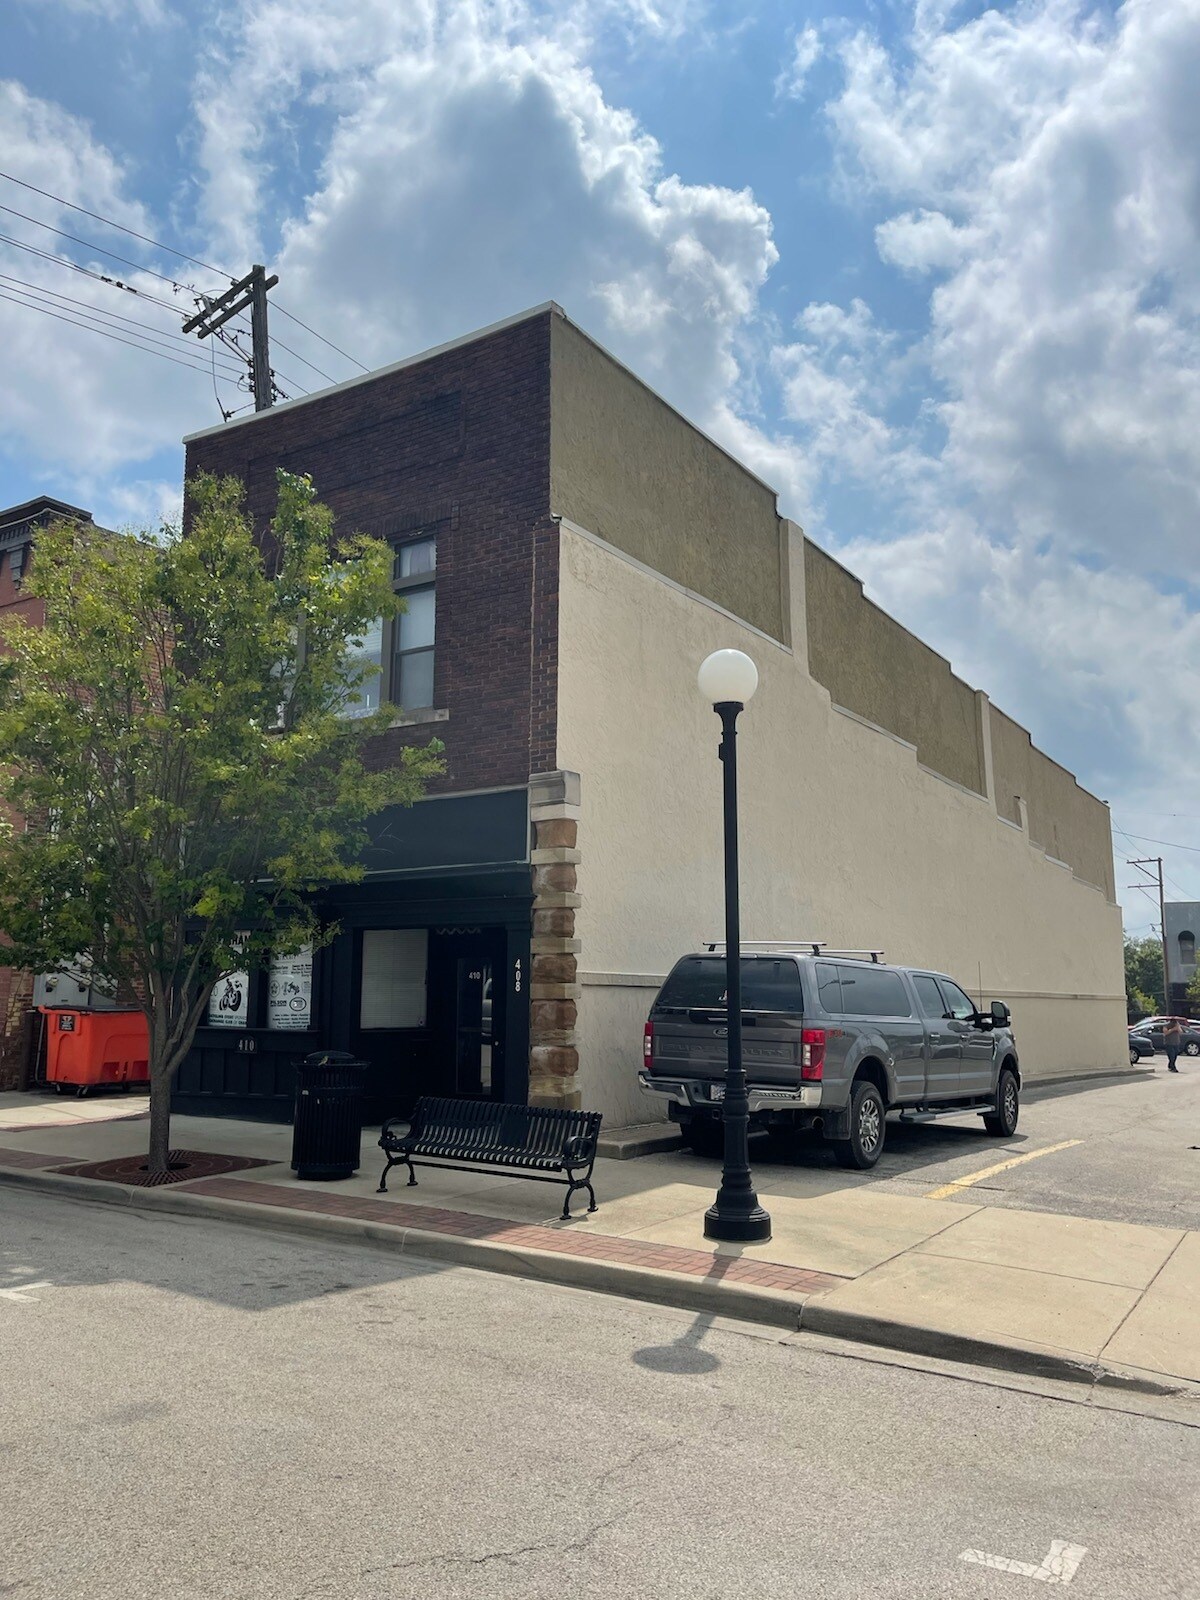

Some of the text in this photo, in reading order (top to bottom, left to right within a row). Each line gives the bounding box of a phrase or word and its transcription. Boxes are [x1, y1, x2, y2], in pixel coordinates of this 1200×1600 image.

[469, 972, 481, 980] 410
[514, 959, 522, 992] 408
[238, 1039, 255, 1051] 410
